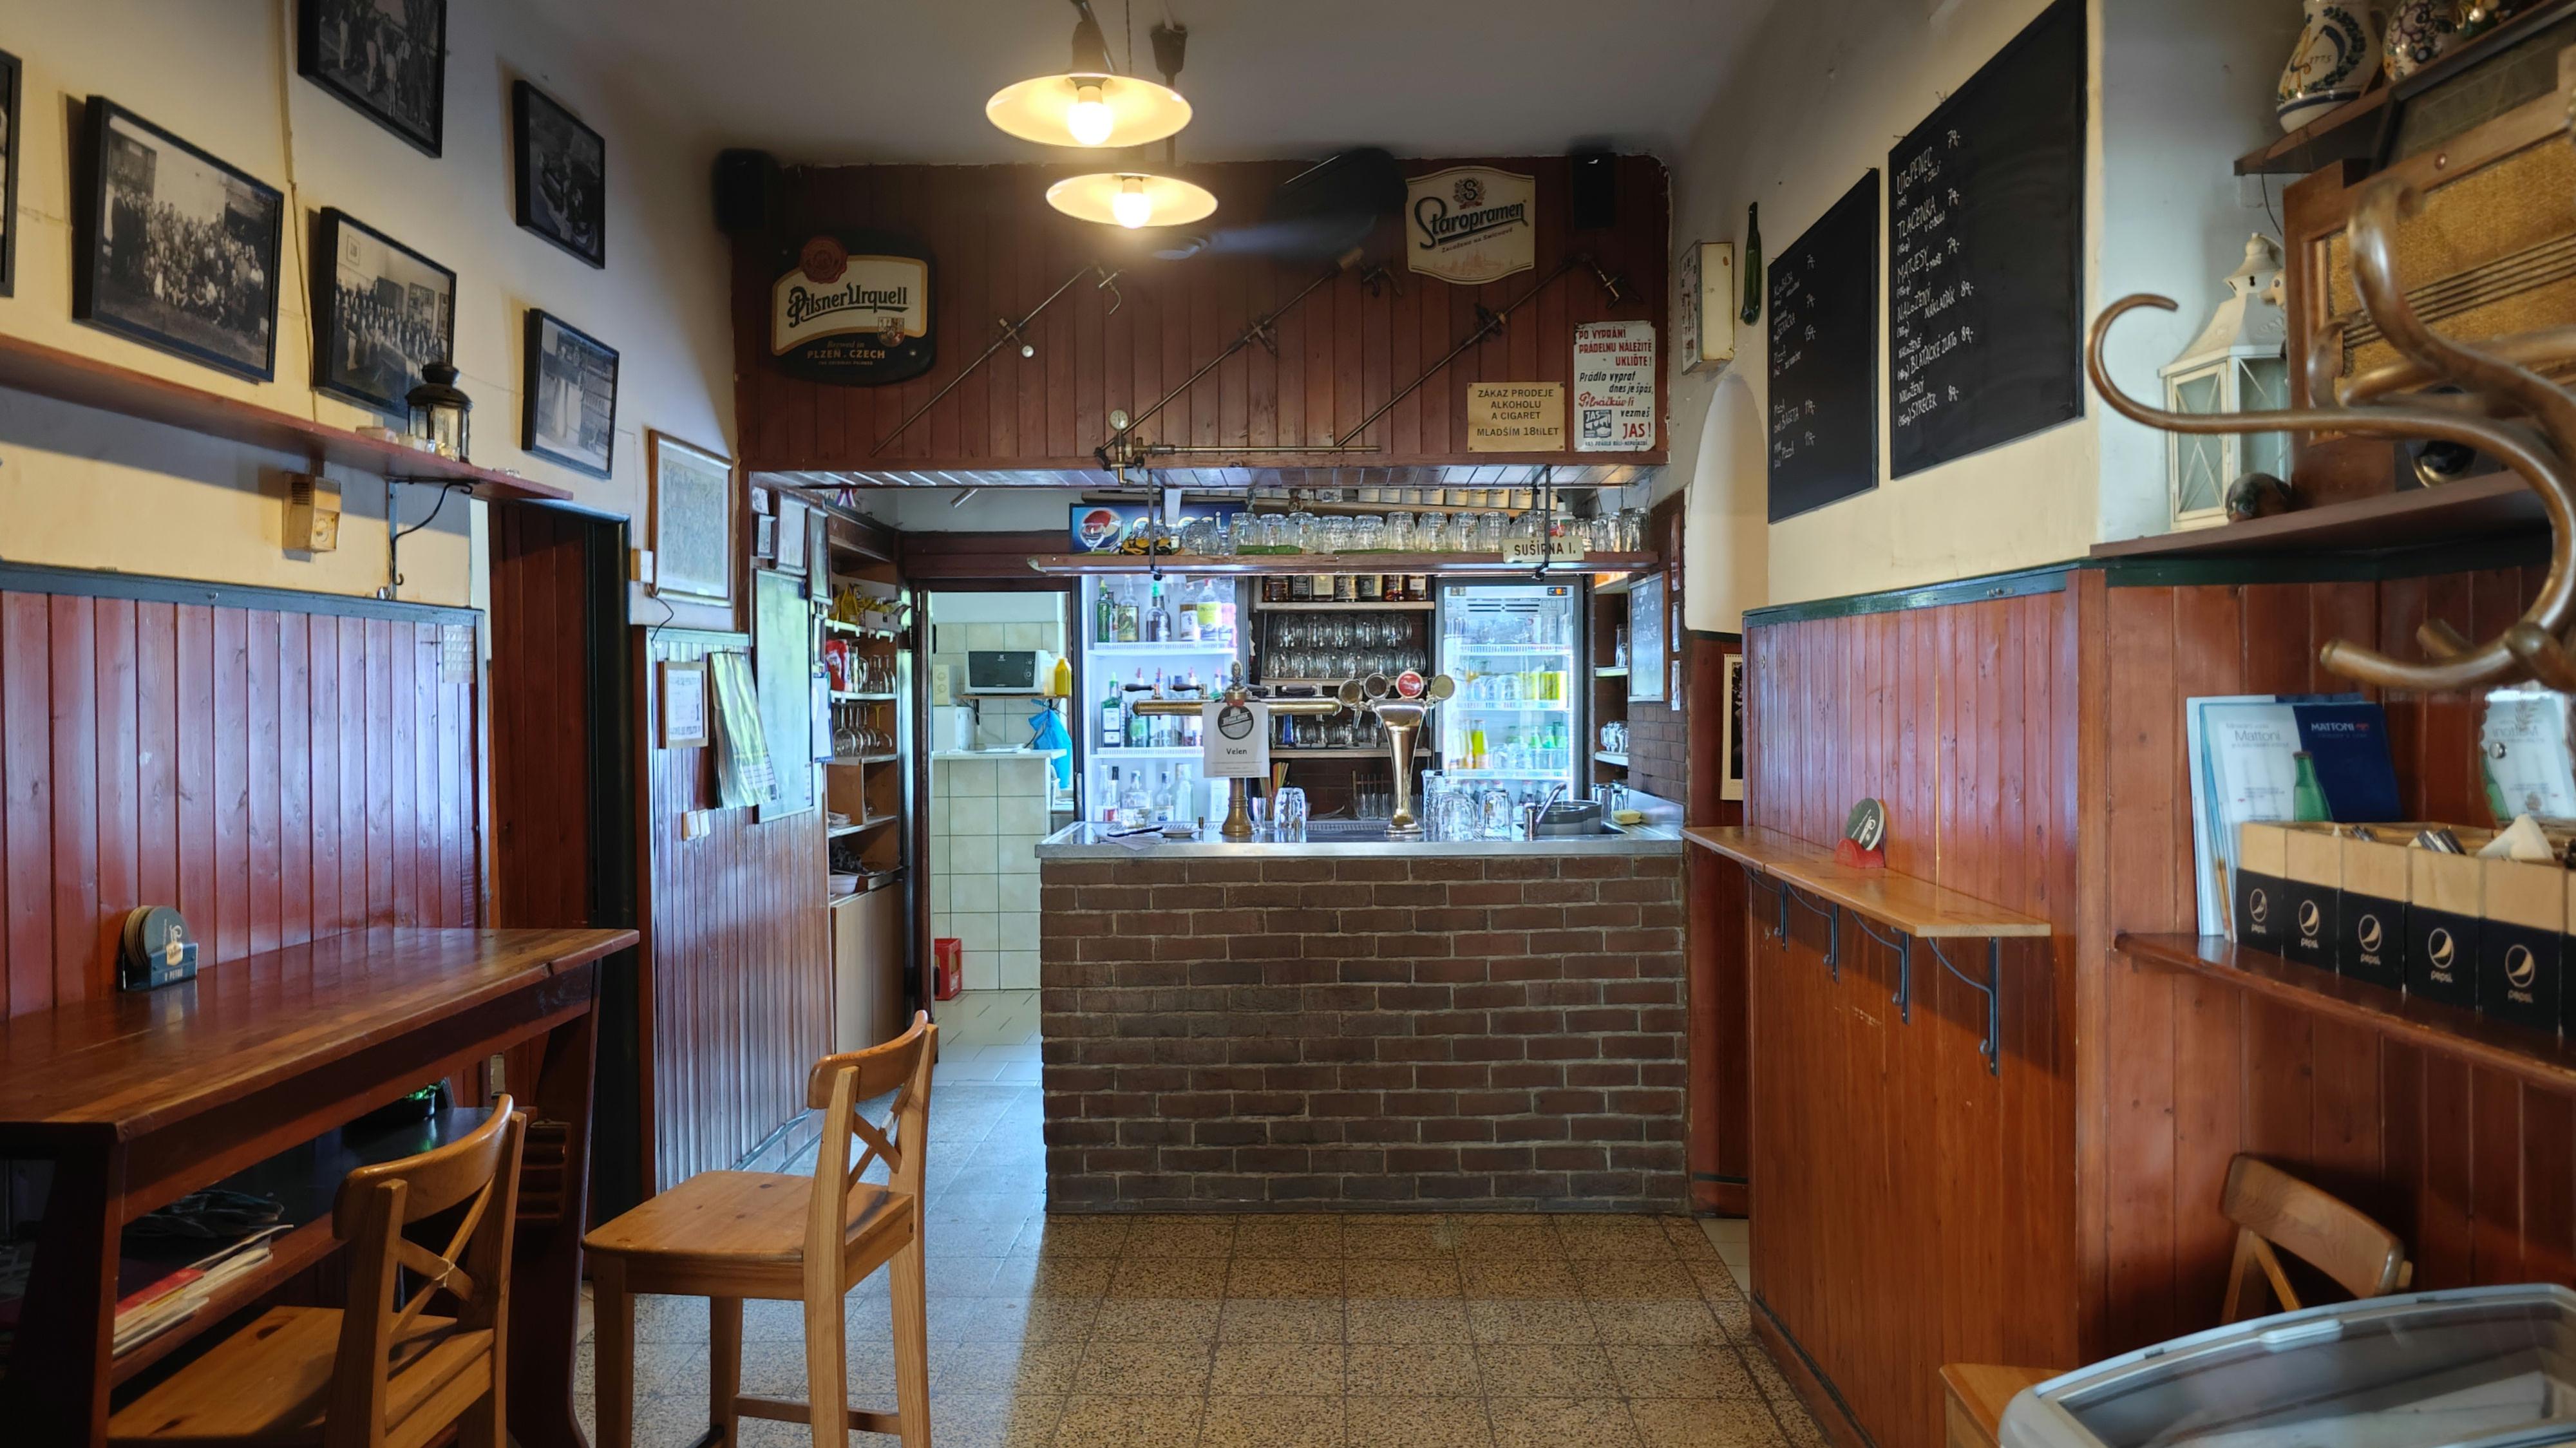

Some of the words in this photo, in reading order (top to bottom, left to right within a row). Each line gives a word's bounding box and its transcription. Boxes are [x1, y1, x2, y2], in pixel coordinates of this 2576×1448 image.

[1414, 196, 1524, 250] Staropramen
[787, 286, 848, 328] Pilsner
[846, 282, 907, 313] Urquell
[1579, 329, 1589, 340] PO
[1593, 326, 1627, 339] VYPRÁNÍ
[1579, 341, 1616, 353] PRÁDELNU
[1618, 339, 1653, 352] NÁLEŽITĚ
[849, 349, 886, 359] CZECH
[1579, 371, 1607, 382] Prádlo
[1609, 371, 1636, 384] vyprat
[1478, 389, 1508, 398] ZÁKAZ
[1511, 389, 1554, 398] PRODEJE
[1609, 384, 1627, 393] dnes
[1627, 382, 1636, 395] je
[1491, 400, 1541, 409] ALKOHOLU
[1492, 412, 1498, 420] A
[1501, 411, 1540, 420] CIGARET
[1620, 407, 1650, 417] vezmeš
[1477, 426, 1520, 436] MLADŠÍM
[1514, 540, 1564, 556] SUŠÍRNA
[2311, 722, 2354, 731] MATTONI
[2234, 729, 2280, 742] Mattoni
